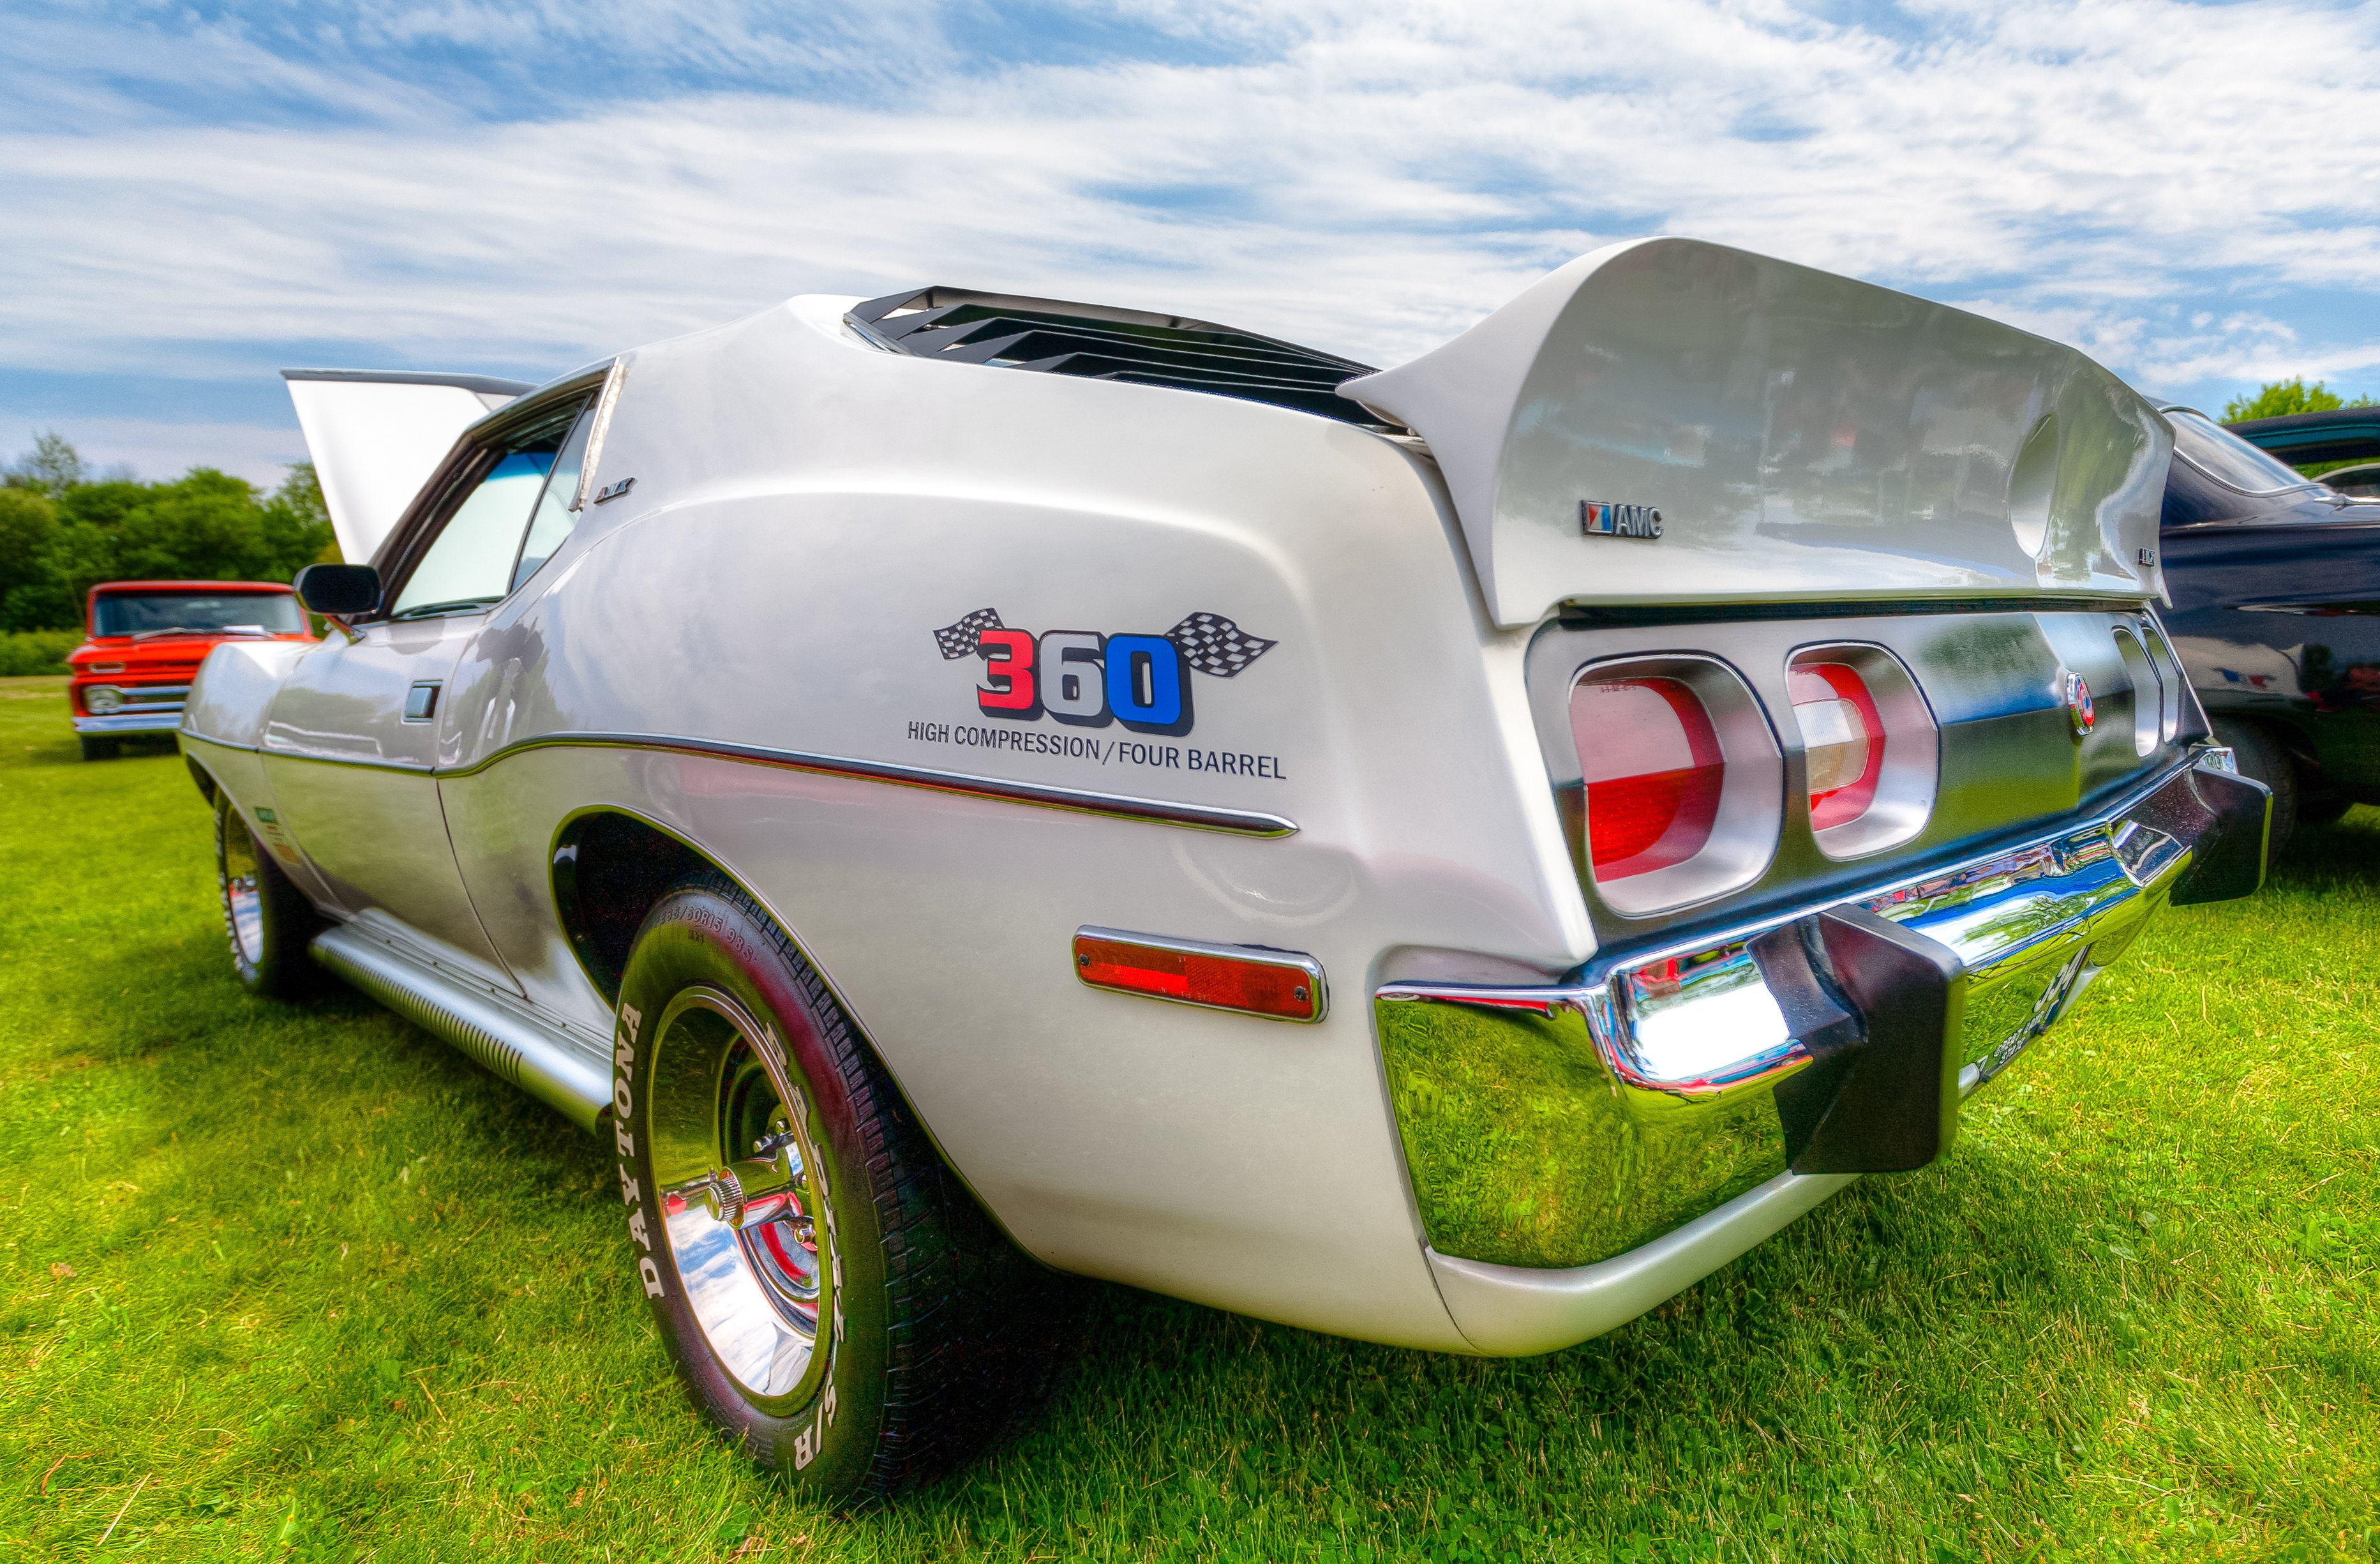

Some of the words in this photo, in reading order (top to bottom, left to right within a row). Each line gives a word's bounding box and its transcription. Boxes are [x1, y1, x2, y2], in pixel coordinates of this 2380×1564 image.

[1613, 504, 1664, 539] AMC
[976, 627, 1194, 737] 360
[908, 721, 949, 742] HIGH
[1188, 749, 1287, 780] BARREL
[613, 1002, 665, 1299] DAYTONA
